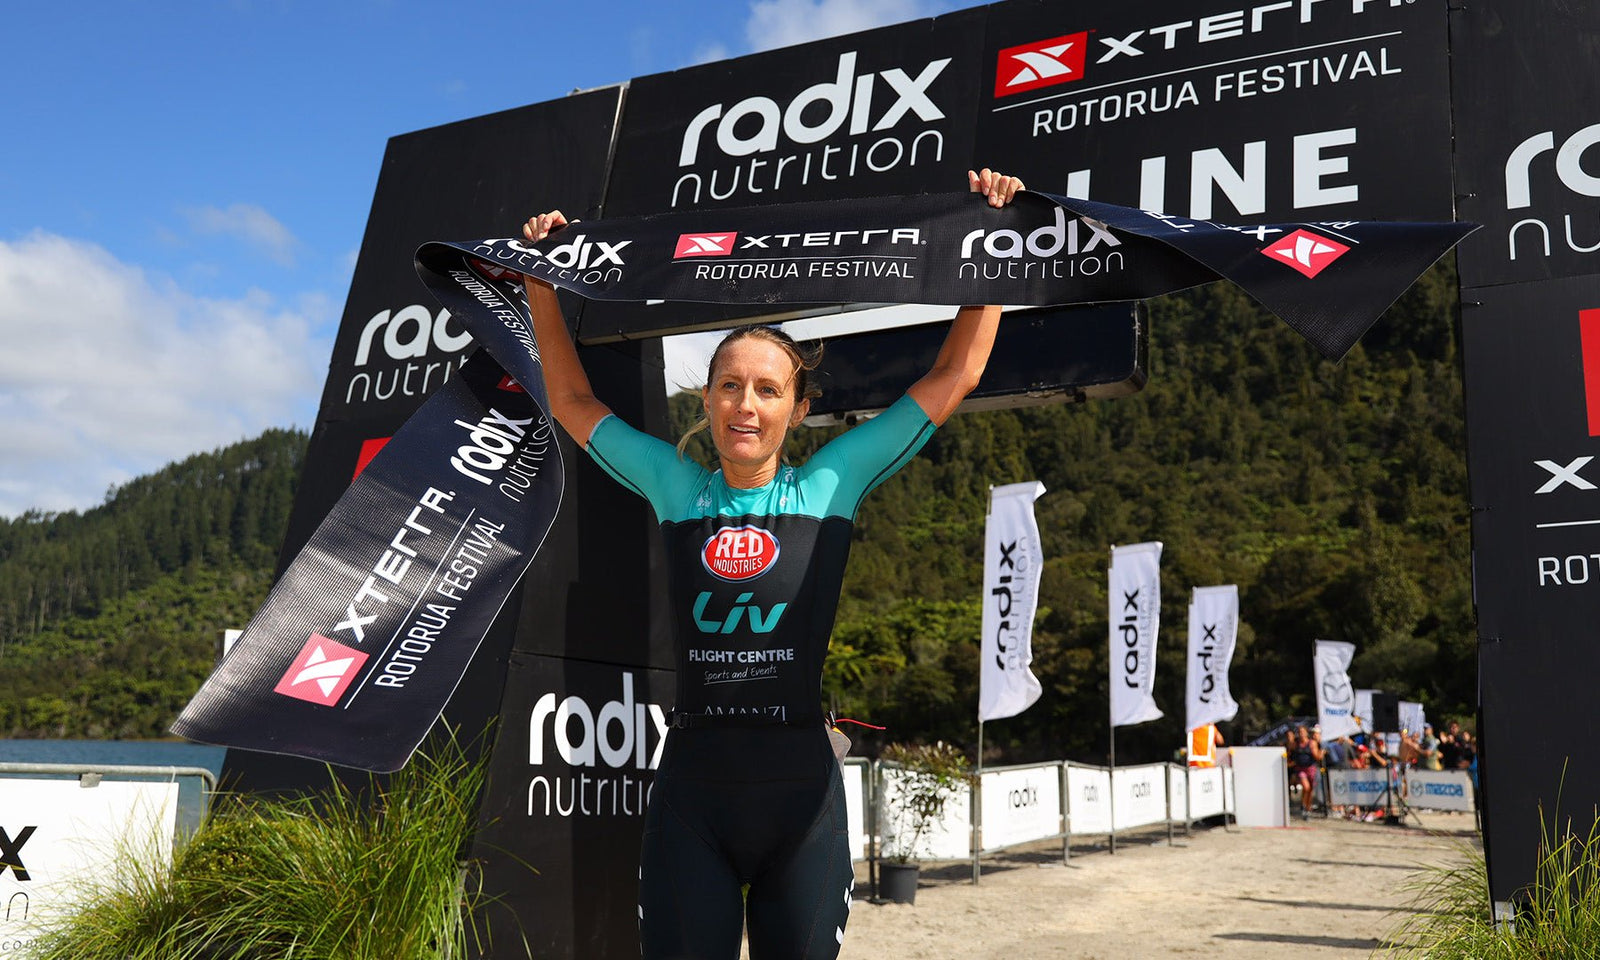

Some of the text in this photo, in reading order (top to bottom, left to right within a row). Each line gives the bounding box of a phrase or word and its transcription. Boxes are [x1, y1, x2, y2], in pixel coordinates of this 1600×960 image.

[679, 51, 953, 168] radix
[1032, 47, 1402, 137] ROTORUA FESTIVAL
[671, 129, 944, 208] nutrition
[961, 205, 1122, 259] radix
[473, 244, 623, 285] nutrition
[694, 260, 915, 280] ROTORUA FESTIVAL
[959, 251, 1125, 281] nutrition
[448, 270, 505, 309] ROTORUA
[345, 355, 469, 404] nutri
[450, 407, 534, 486] radix
[713, 557, 763, 575] INDUSTRIES
[714, 531, 764, 559] RED
[374, 517, 506, 688] ROTORUA FESTIVAL
[692, 591, 788, 634] Liv
[689, 648, 794, 663] FLIGHT CENTRE
[1119, 588, 1140, 689] radix
[704, 665, 777, 683] Sports and Events
[528, 772, 655, 817] nutriti
[1425, 783, 1464, 797] mazda
